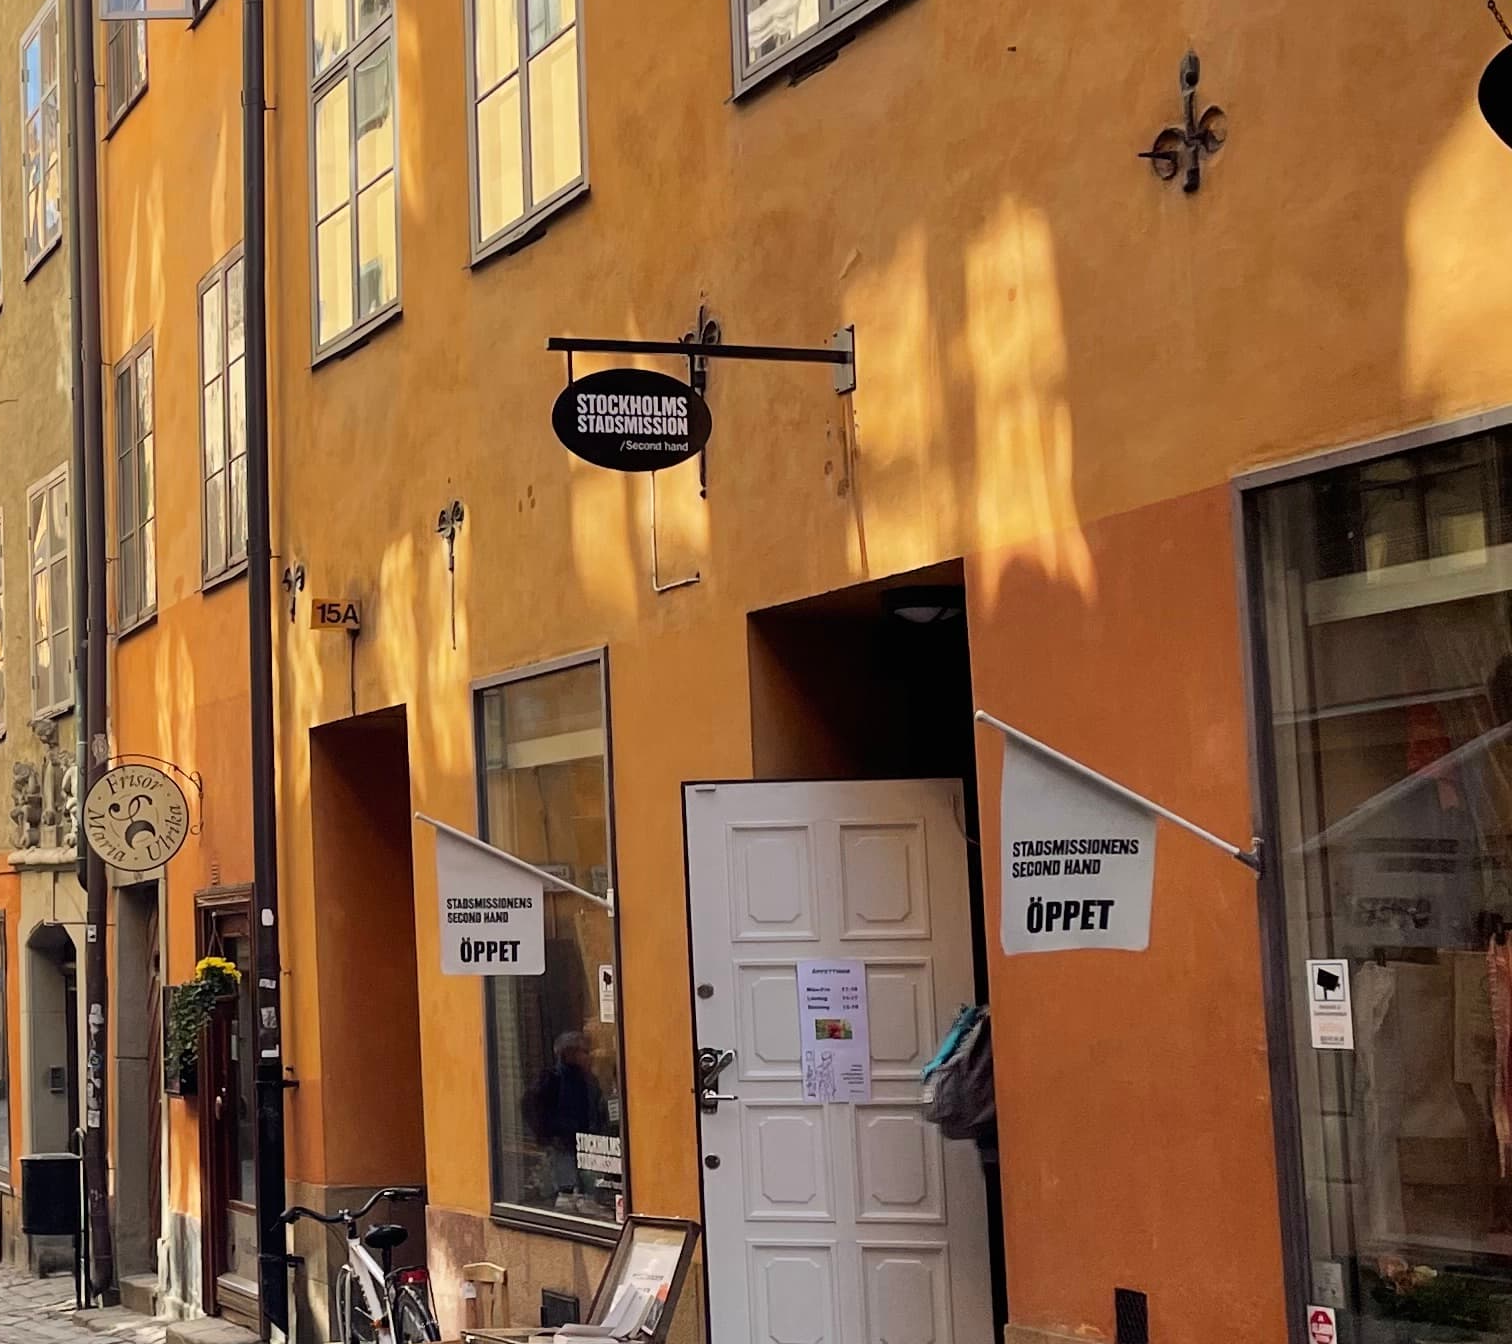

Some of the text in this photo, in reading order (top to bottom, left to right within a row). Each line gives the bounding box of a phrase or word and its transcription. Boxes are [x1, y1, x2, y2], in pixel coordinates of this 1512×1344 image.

[577, 394, 688, 417] STOCKHOLMS
[577, 415, 688, 435] STADSMISSION
[664, 441, 688, 452] hand
[316, 603, 359, 624] 15A
[88, 807, 126, 862] Maria
[145, 805, 182, 862] Ulrika
[1012, 839, 1139, 857] STADSMISSIONENS
[1012, 859, 1101, 878] SECOND HAND
[446, 898, 533, 909] STADSMISSIONENS
[447, 911, 509, 923] SECOND HAND
[1027, 896, 1115, 933] ÖPPET
[460, 937, 521, 963] ÖPPET
